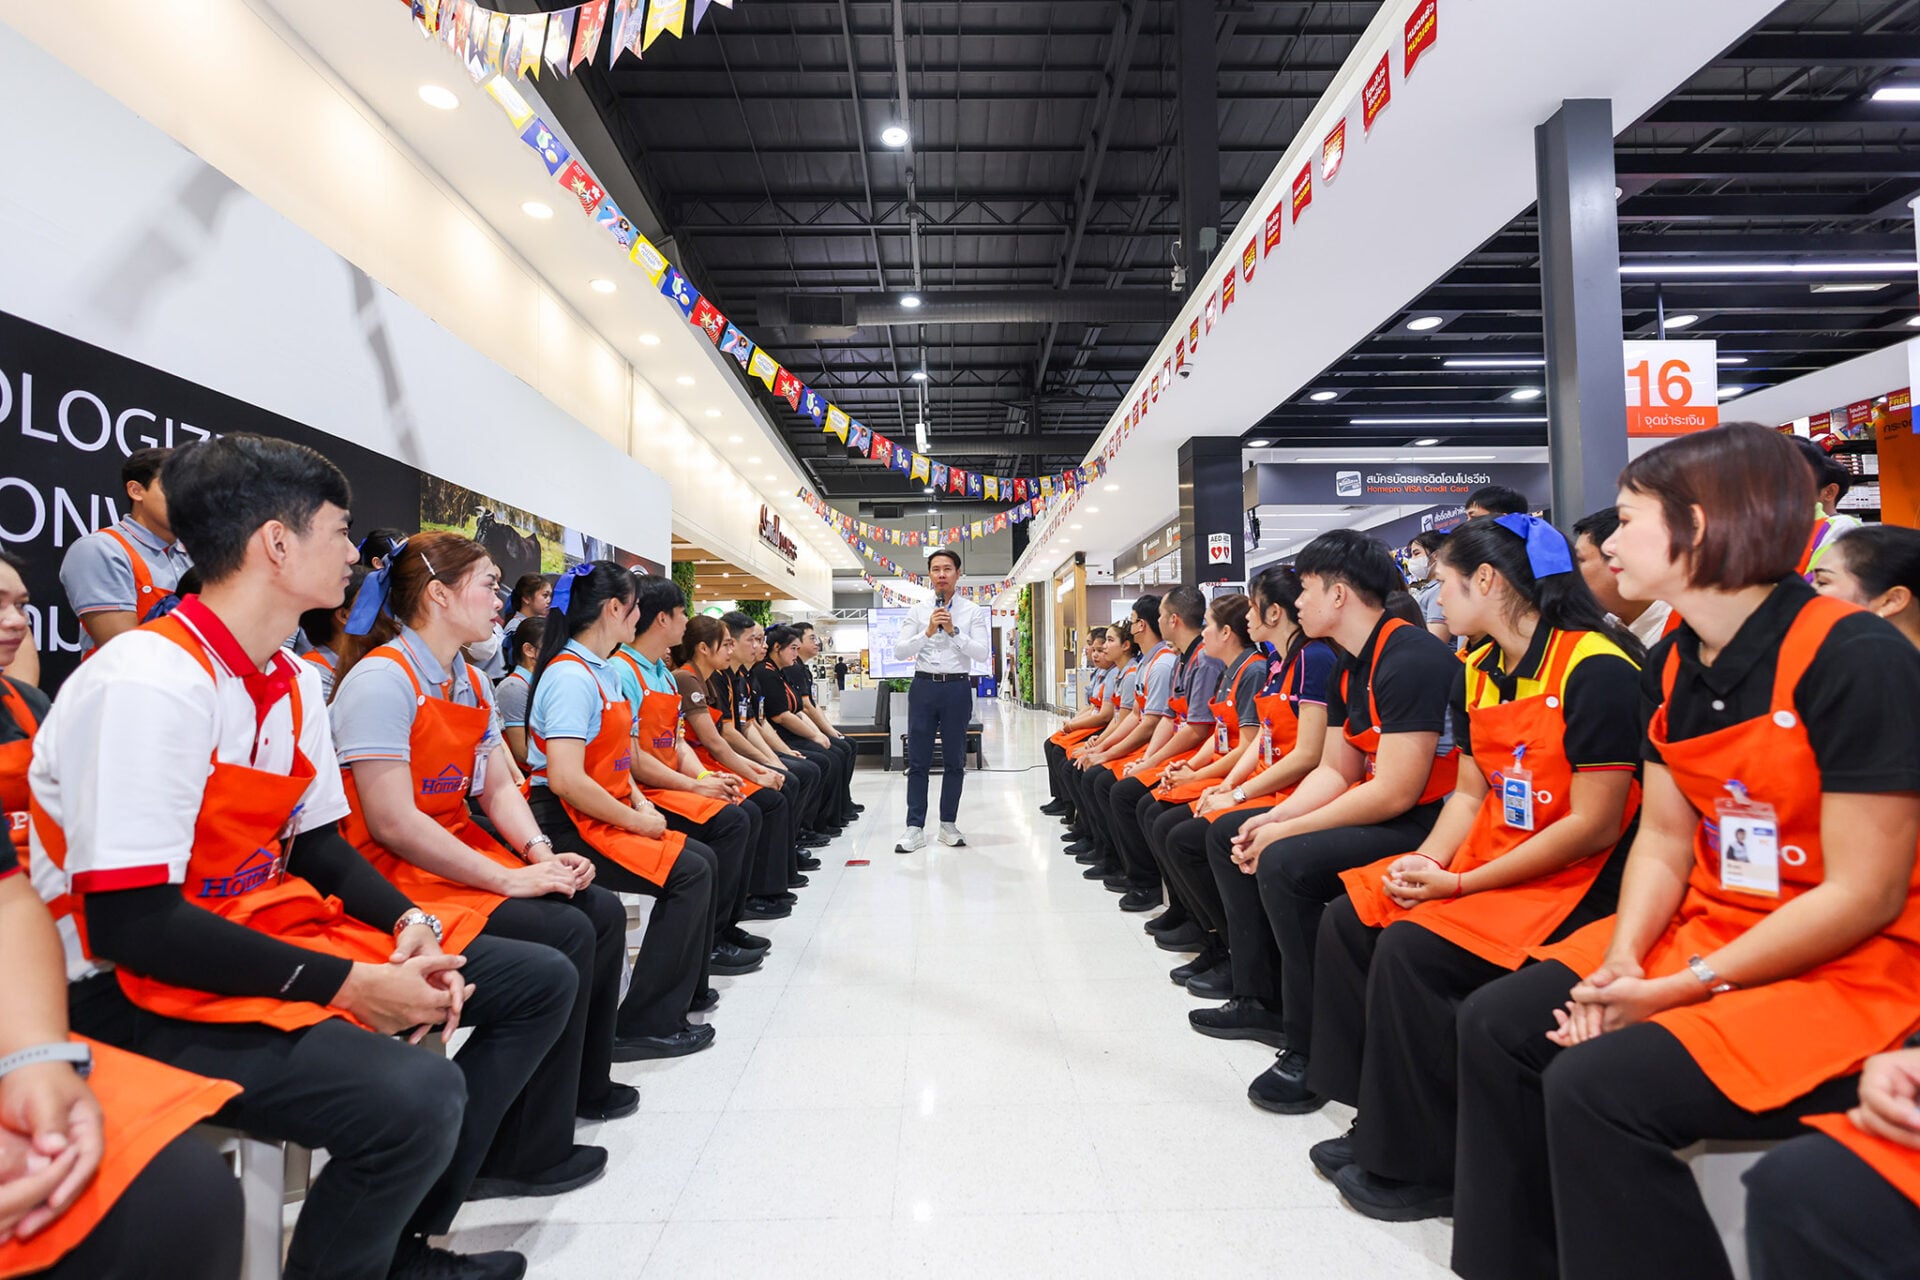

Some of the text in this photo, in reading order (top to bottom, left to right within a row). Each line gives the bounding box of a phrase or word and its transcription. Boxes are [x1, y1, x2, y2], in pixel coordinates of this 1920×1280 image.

[1627, 359, 1693, 408] 16
[1644, 413, 1705, 429] จุดชำระเงิน
[1366, 473, 1491, 484] สมัครบัตรเครดิตโฮมโปรวีซ่า
[1404, 485, 1422, 493] VISA
[1424, 485, 1447, 493] Credit
[1450, 485, 1469, 493] Card
